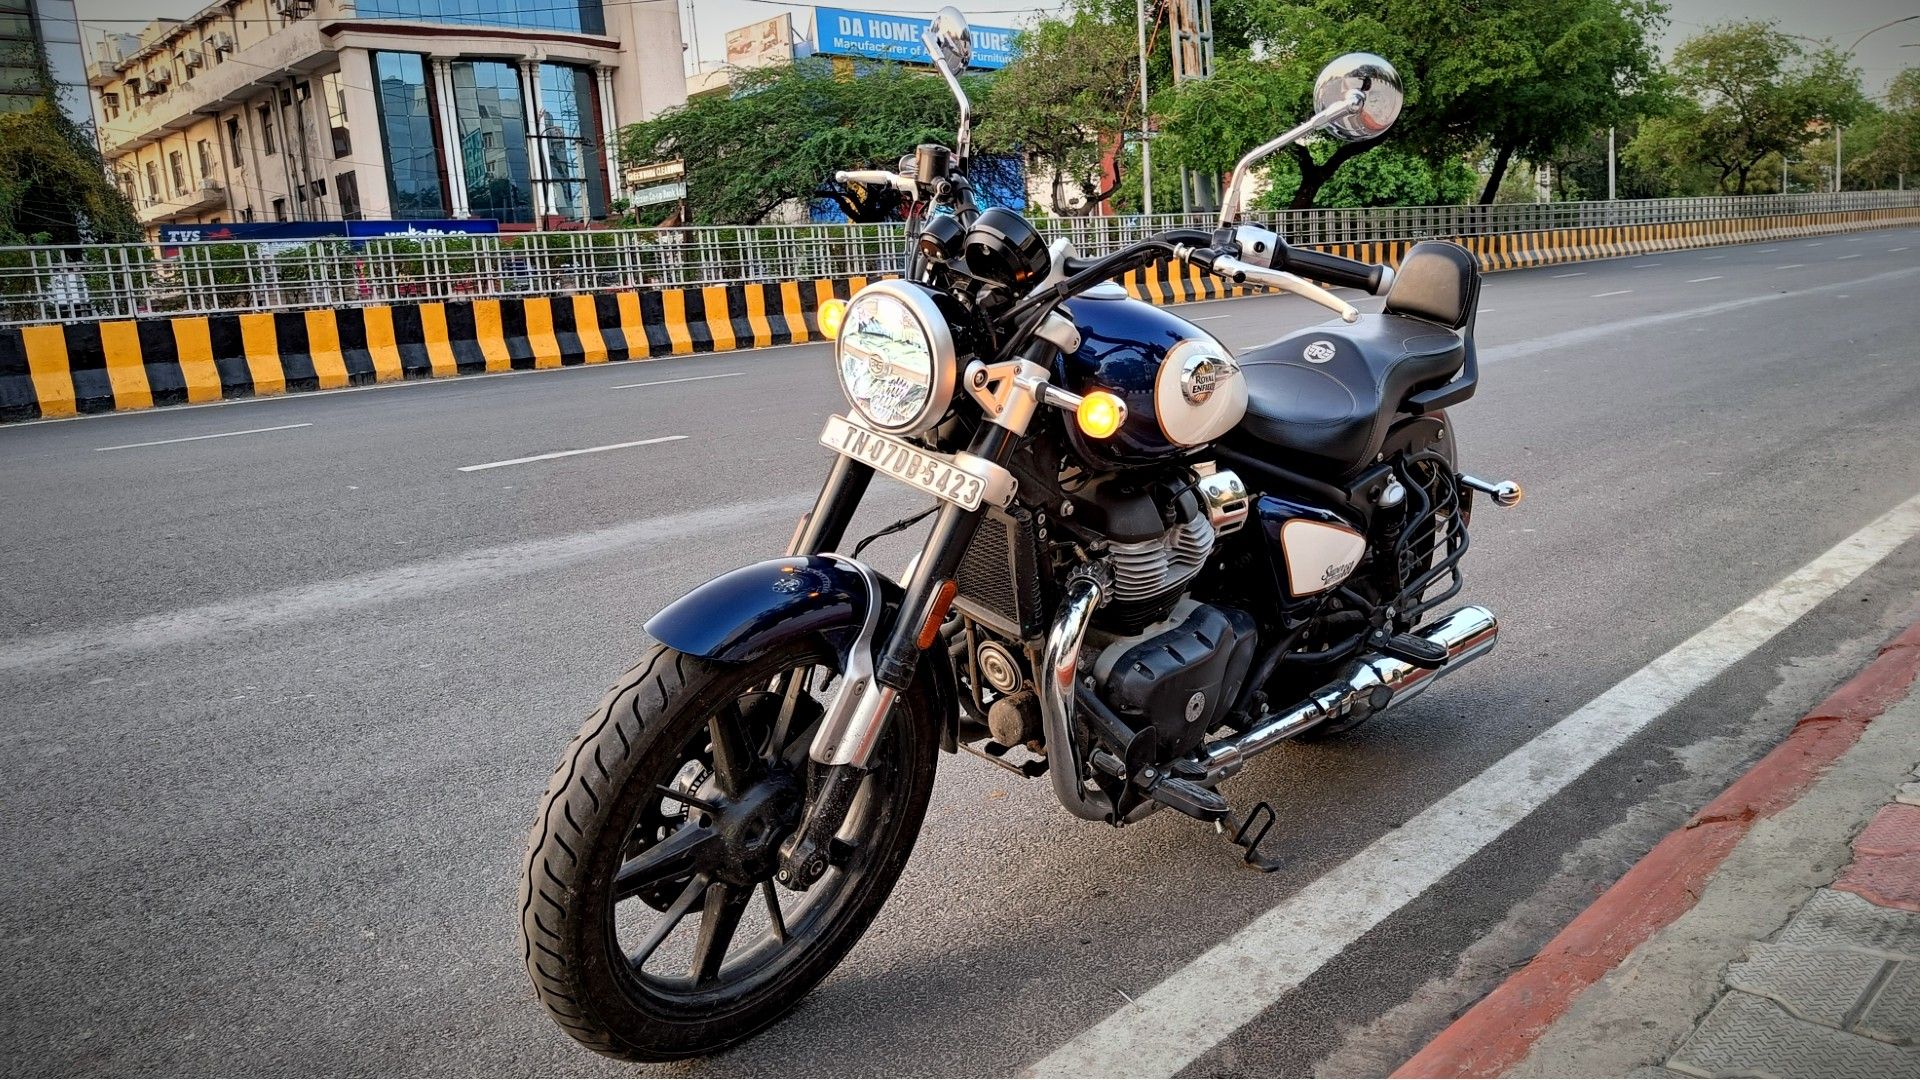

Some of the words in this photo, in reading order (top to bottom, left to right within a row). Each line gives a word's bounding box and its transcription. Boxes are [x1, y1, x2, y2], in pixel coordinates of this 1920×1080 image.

[838, 16, 864, 37] DA
[868, 19, 920, 42] HOME
[910, 46, 921, 55] of
[168, 230, 201, 242] TVS
